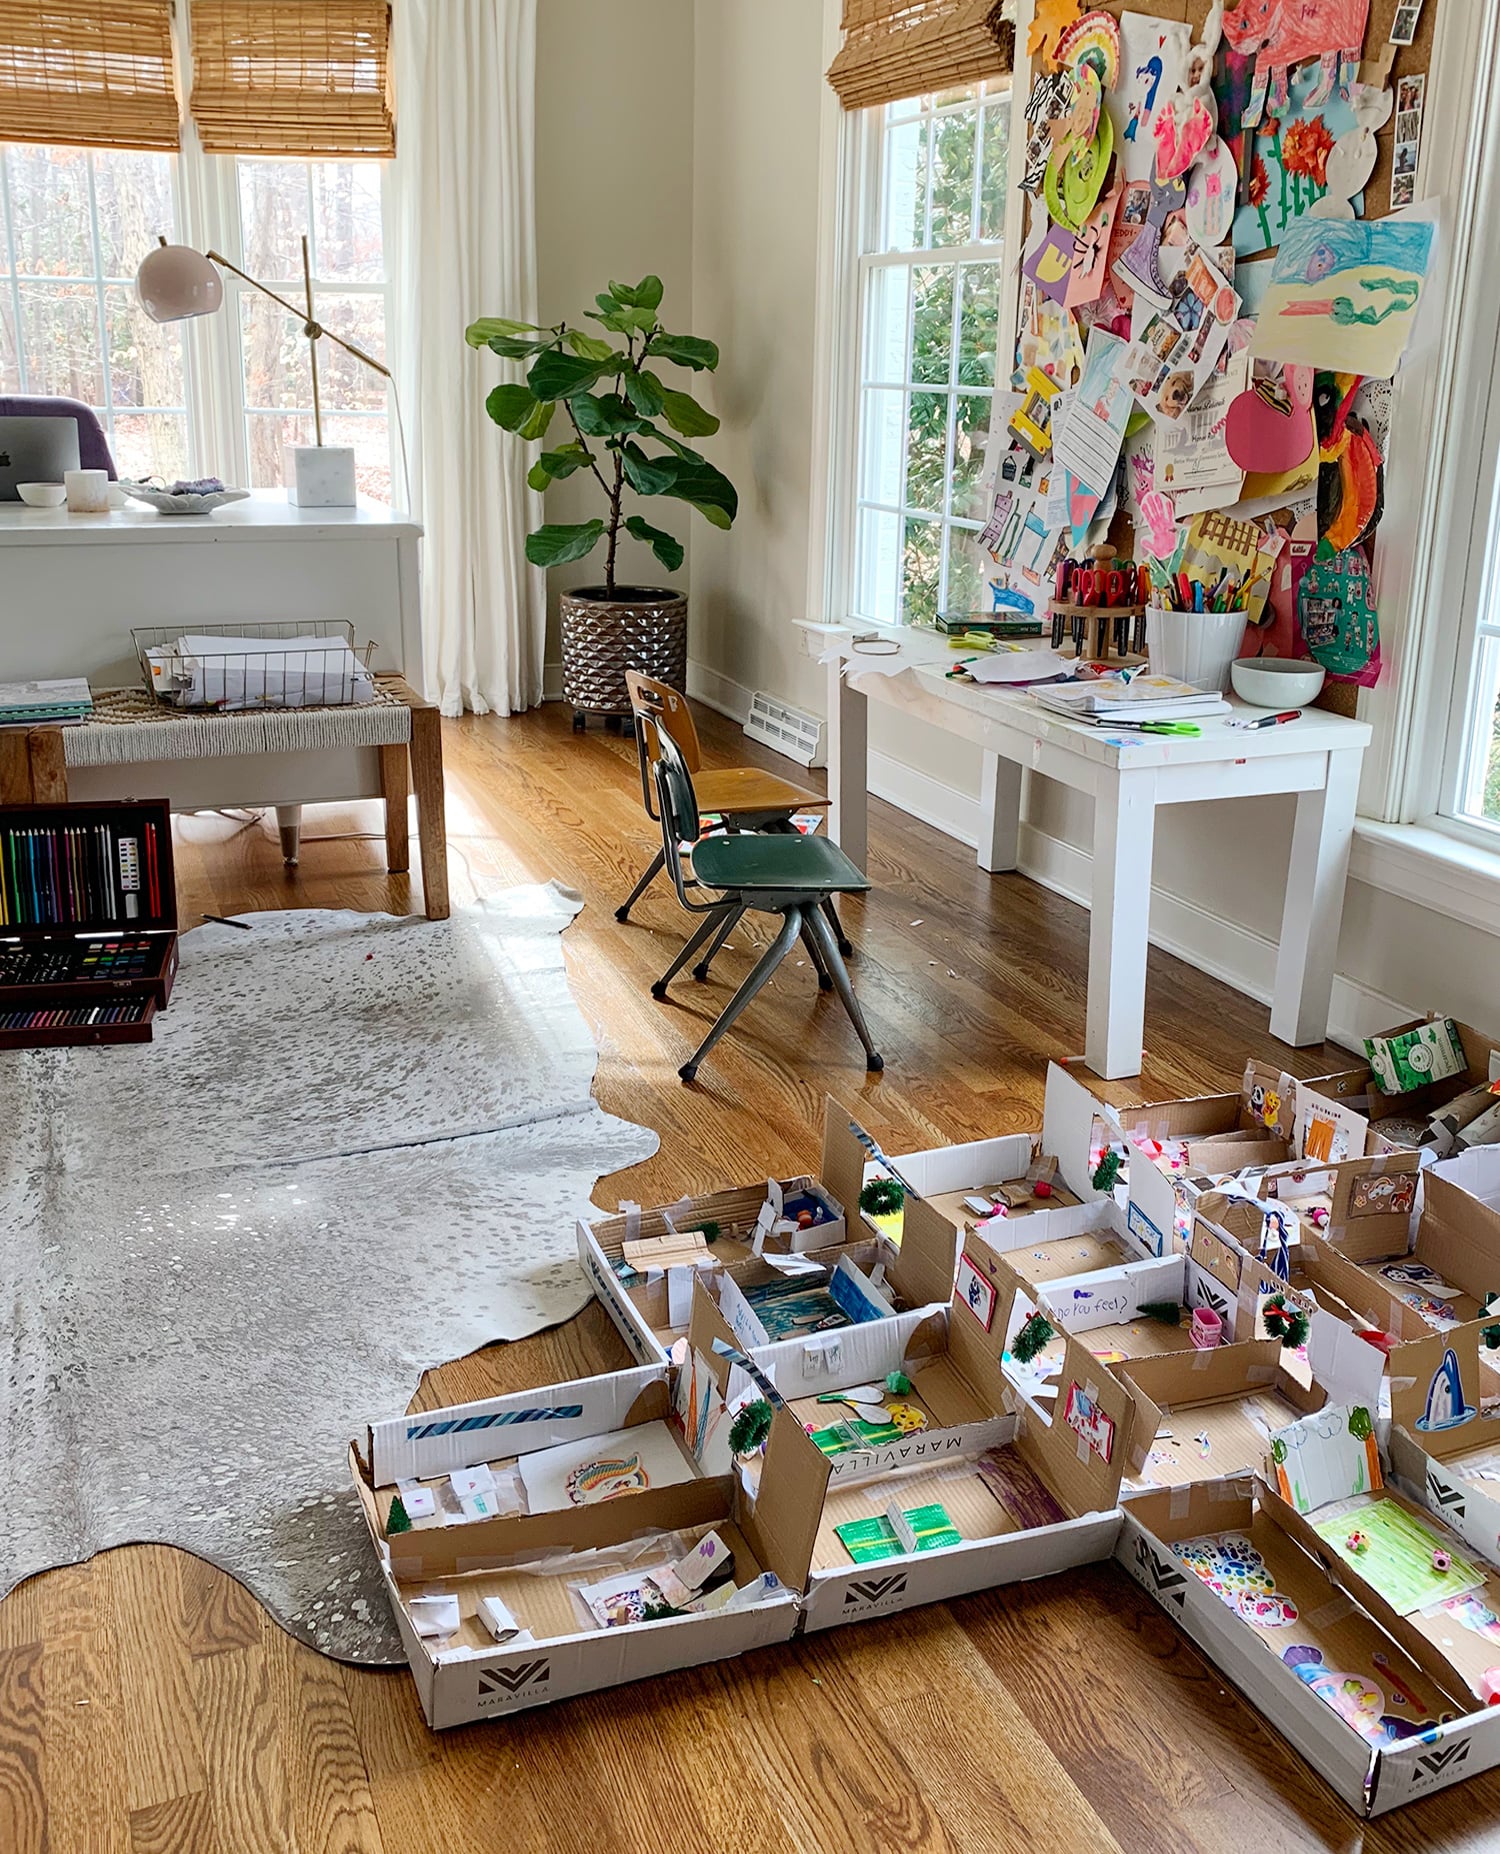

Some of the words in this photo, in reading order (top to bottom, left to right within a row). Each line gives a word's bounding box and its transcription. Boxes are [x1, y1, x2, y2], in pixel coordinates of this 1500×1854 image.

[833, 1437, 962, 1475] MARAVILLA
[841, 1597, 903, 1615] MARAVILLA
[1132, 1565, 1186, 1622] MARAVILLA
[477, 1686, 550, 1708] MARAVILLA
